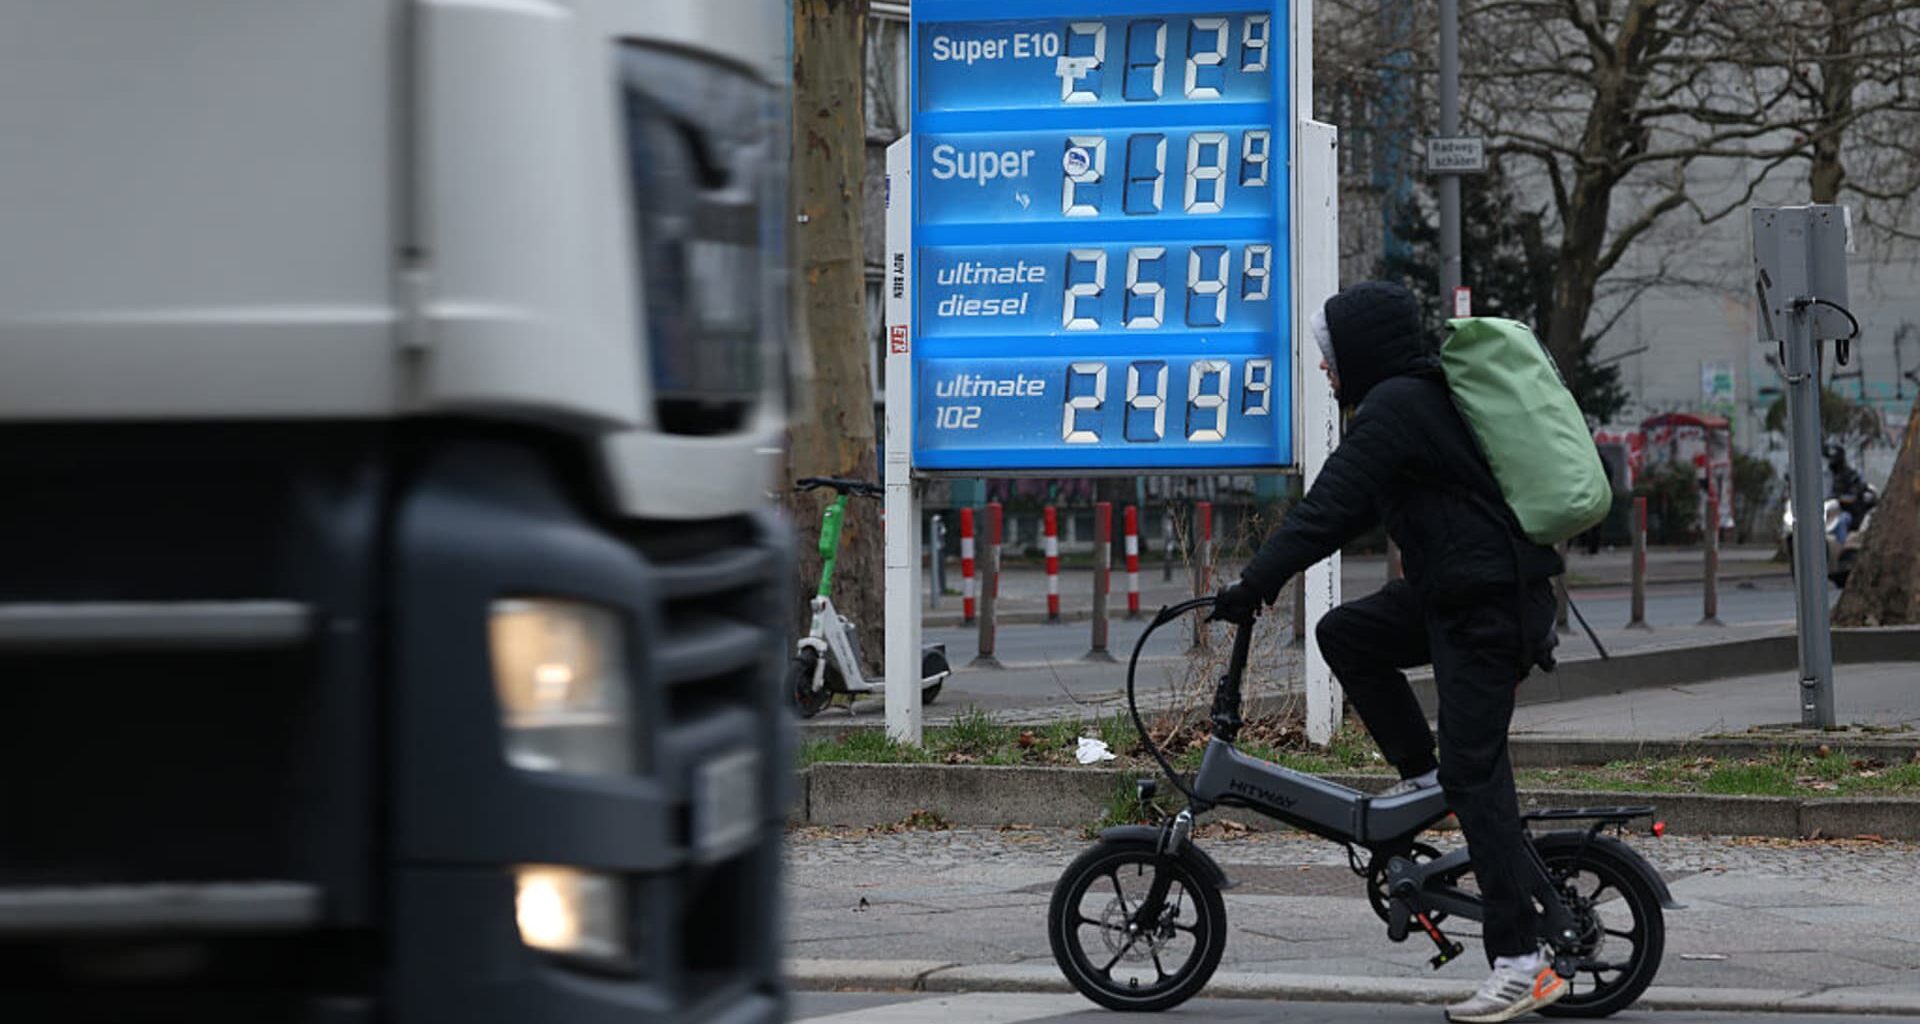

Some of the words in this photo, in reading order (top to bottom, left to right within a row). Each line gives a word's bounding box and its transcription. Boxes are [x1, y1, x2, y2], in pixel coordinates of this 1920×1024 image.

[932, 36, 1008, 65] Super
[1013, 33, 1059, 58] E10
[932, 145, 1035, 187] Super
[937, 260, 1046, 285] ultimate
[937, 293, 1029, 317] diesel
[936, 373, 1046, 397] ultimate
[935, 406, 981, 430] 102
[1229, 777, 1298, 808] HITWAY
